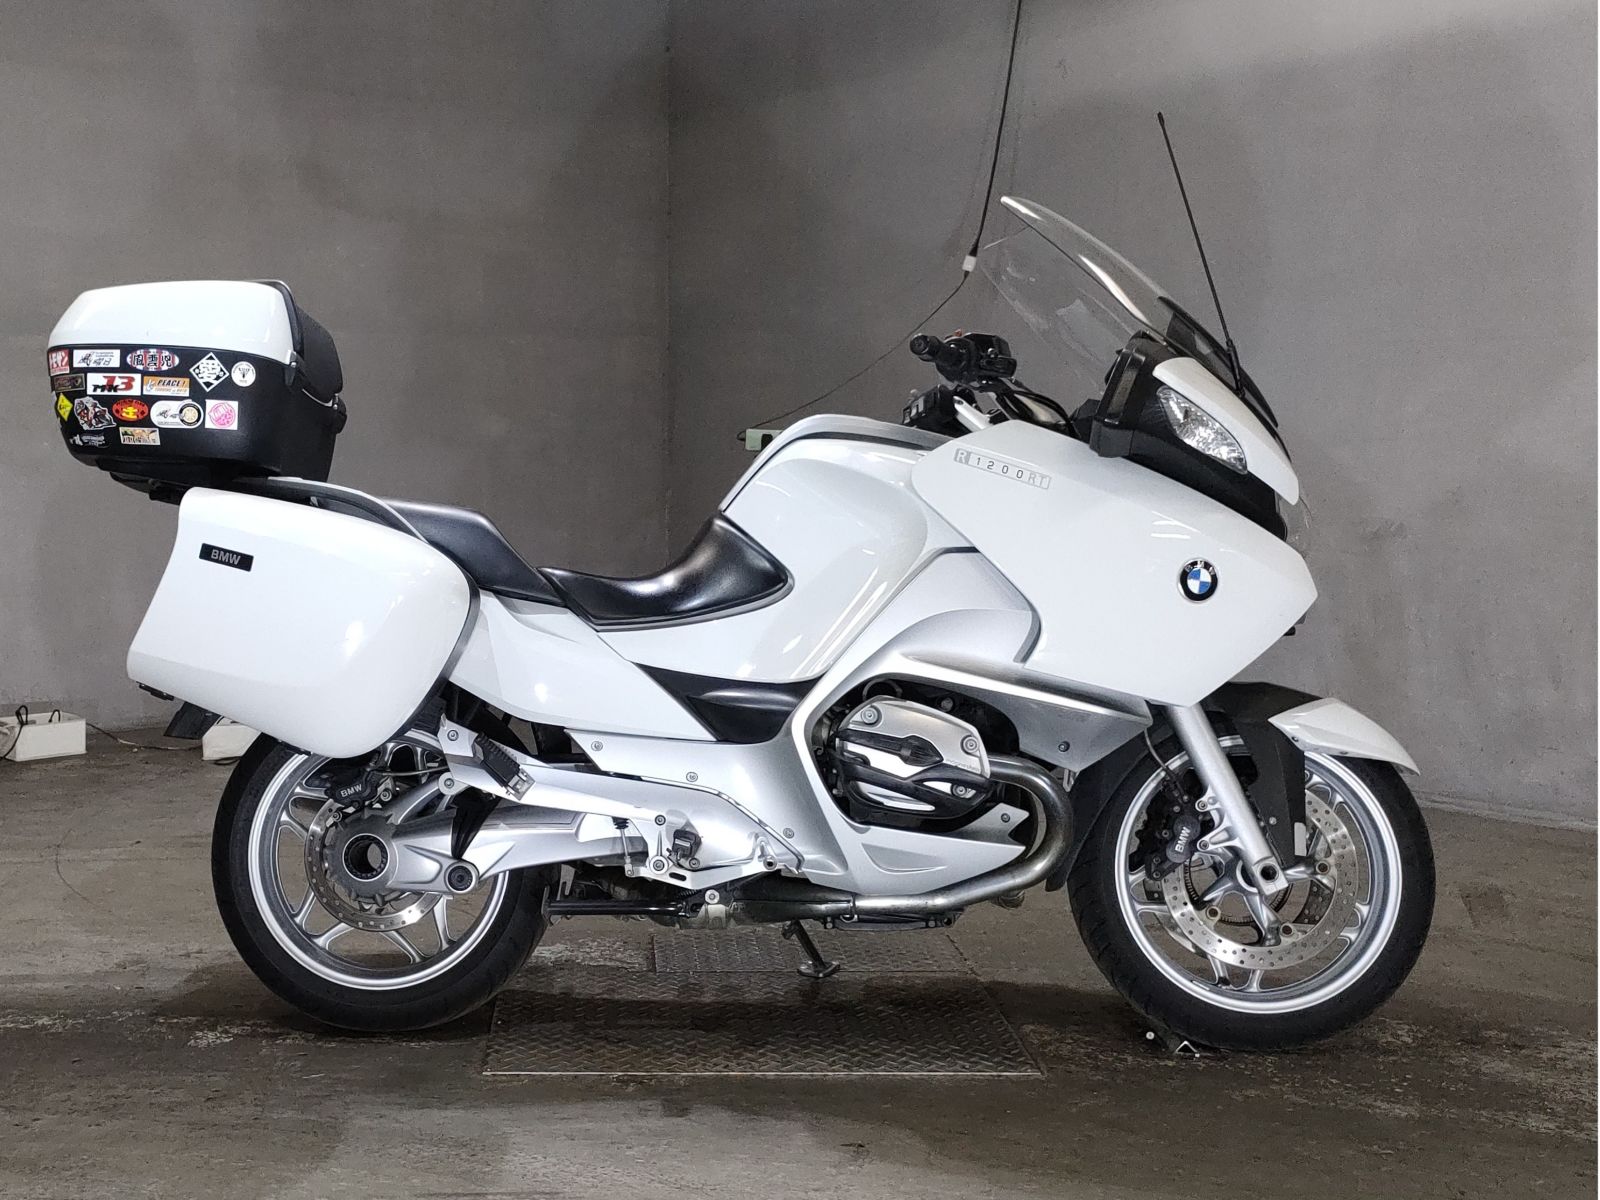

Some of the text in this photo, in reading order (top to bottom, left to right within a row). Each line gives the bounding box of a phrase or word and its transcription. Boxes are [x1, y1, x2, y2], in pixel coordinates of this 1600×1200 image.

[211, 549, 241, 565] BMW
[340, 784, 362, 797] BMW
[1174, 826, 1191, 853] BMW
